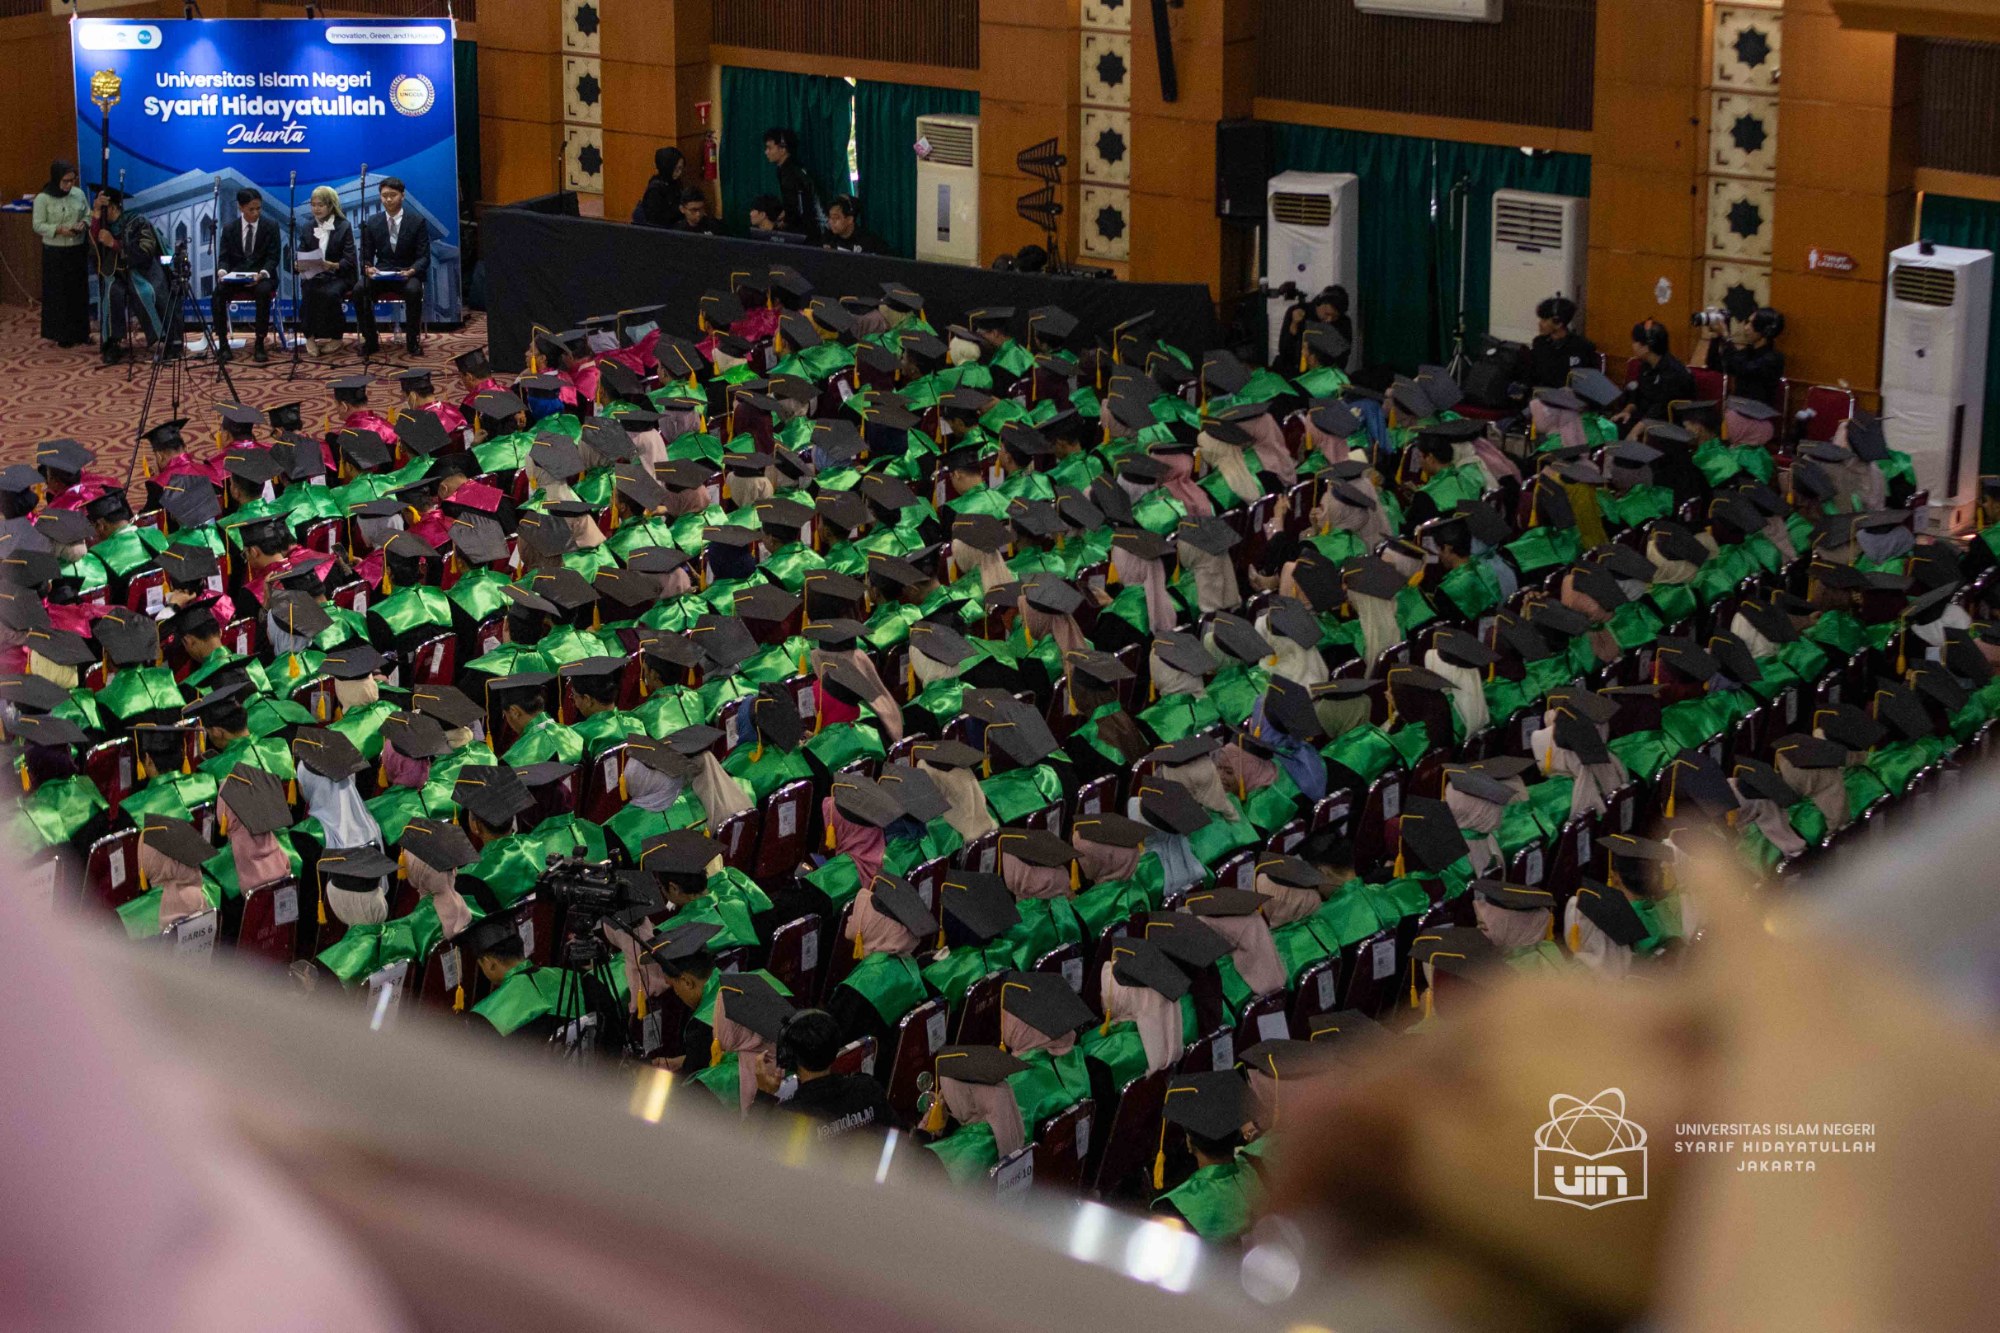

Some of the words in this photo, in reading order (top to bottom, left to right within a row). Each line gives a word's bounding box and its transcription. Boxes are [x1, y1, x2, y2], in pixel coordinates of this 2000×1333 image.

[156, 71, 256, 88] Universitas
[259, 71, 309, 88] Islam
[312, 71, 372, 92] Negeri
[144, 94, 219, 122] Syarif
[222, 94, 386, 122] Hidayatullah
[226, 120, 308, 145] Jakarta
[1022, 1165, 1032, 1179] 10
